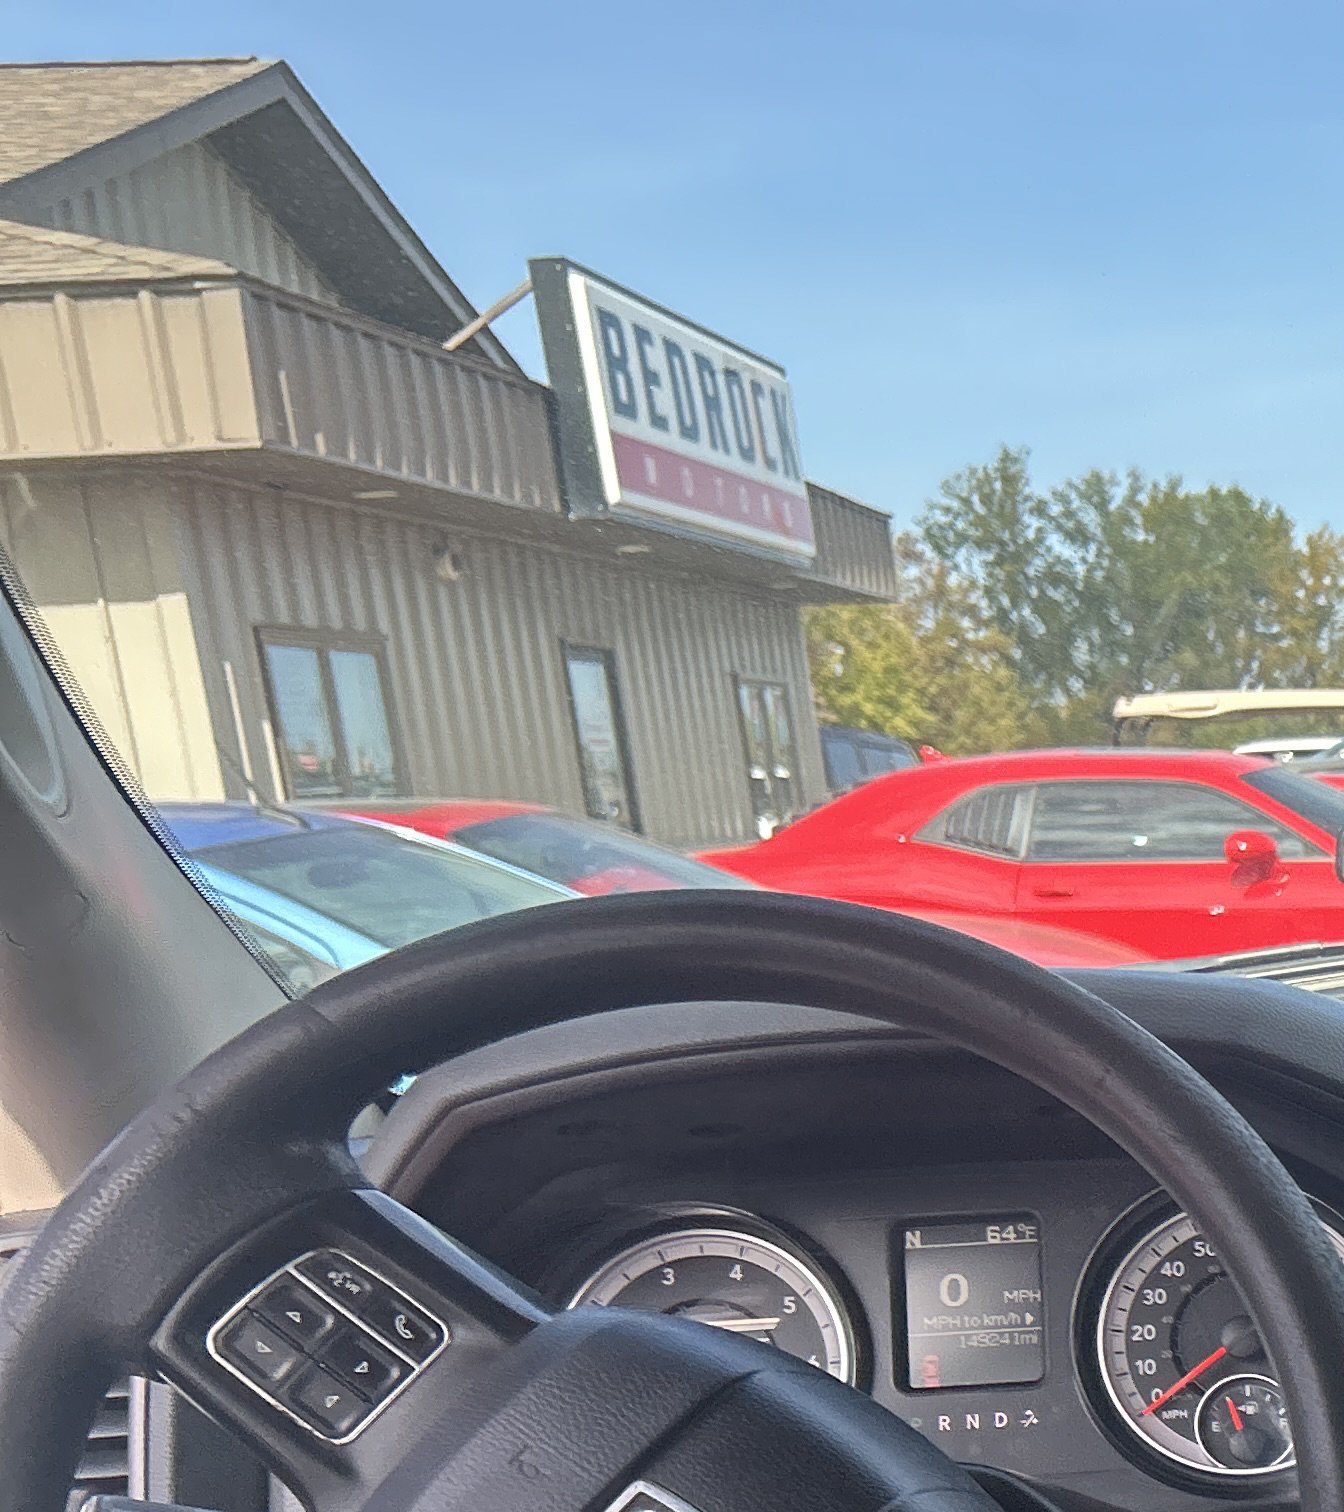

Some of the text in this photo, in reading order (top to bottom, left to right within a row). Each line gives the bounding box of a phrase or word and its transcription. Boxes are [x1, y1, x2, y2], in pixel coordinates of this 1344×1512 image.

[595, 305, 801, 481] BEDROCK
[906, 1230, 921, 1248] N
[661, 1267, 675, 1285] 3
[729, 1264, 743, 1281] 4
[1160, 1260, 1185, 1278] 40
[939, 1273, 969, 1307] 0
[1003, 1289, 1042, 1304] MPH
[1142, 1288, 1167, 1305] 30
[782, 1296, 796, 1314] 5
[923, 1312, 1021, 1330] MPH to km/h
[1131, 1324, 1156, 1341] 20
[1135, 1358, 1157, 1375] 10
[938, 1415, 951, 1431] R
[966, 1413, 980, 1430] N
[994, 1412, 1008, 1428] D
[1162, 1409, 1188, 1420] MPH
[1211, 1422, 1221, 1432] E
